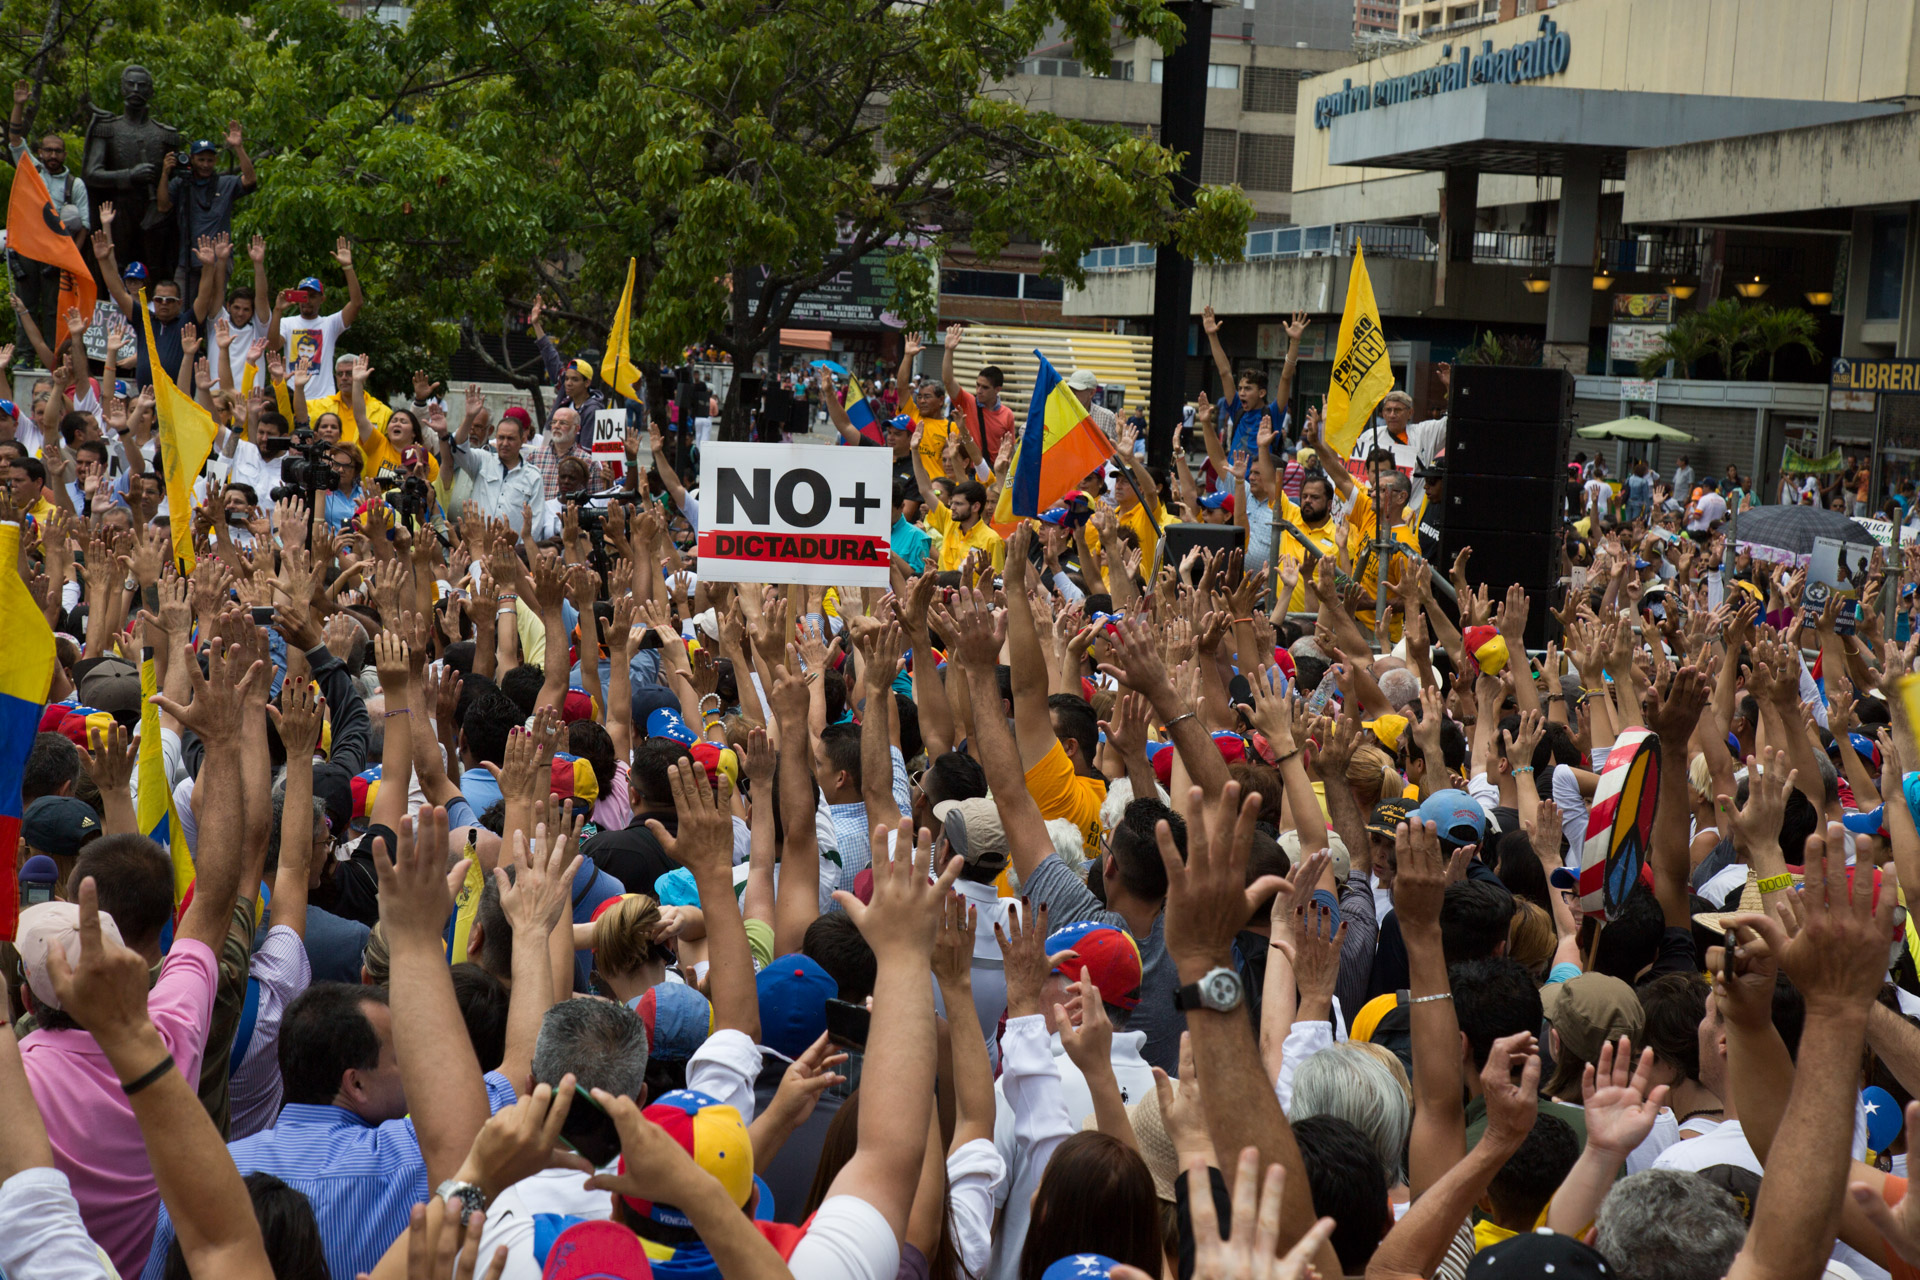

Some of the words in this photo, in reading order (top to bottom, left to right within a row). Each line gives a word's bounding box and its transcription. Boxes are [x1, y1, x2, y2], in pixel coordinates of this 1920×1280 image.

[1314, 78, 1371, 129] centro
[1372, 44, 1470, 108] comercial
[1850, 362, 1920, 391] LIBRERI
[1419, 521, 1440, 542] SHUR
[715, 535, 879, 561] DICTADURA
